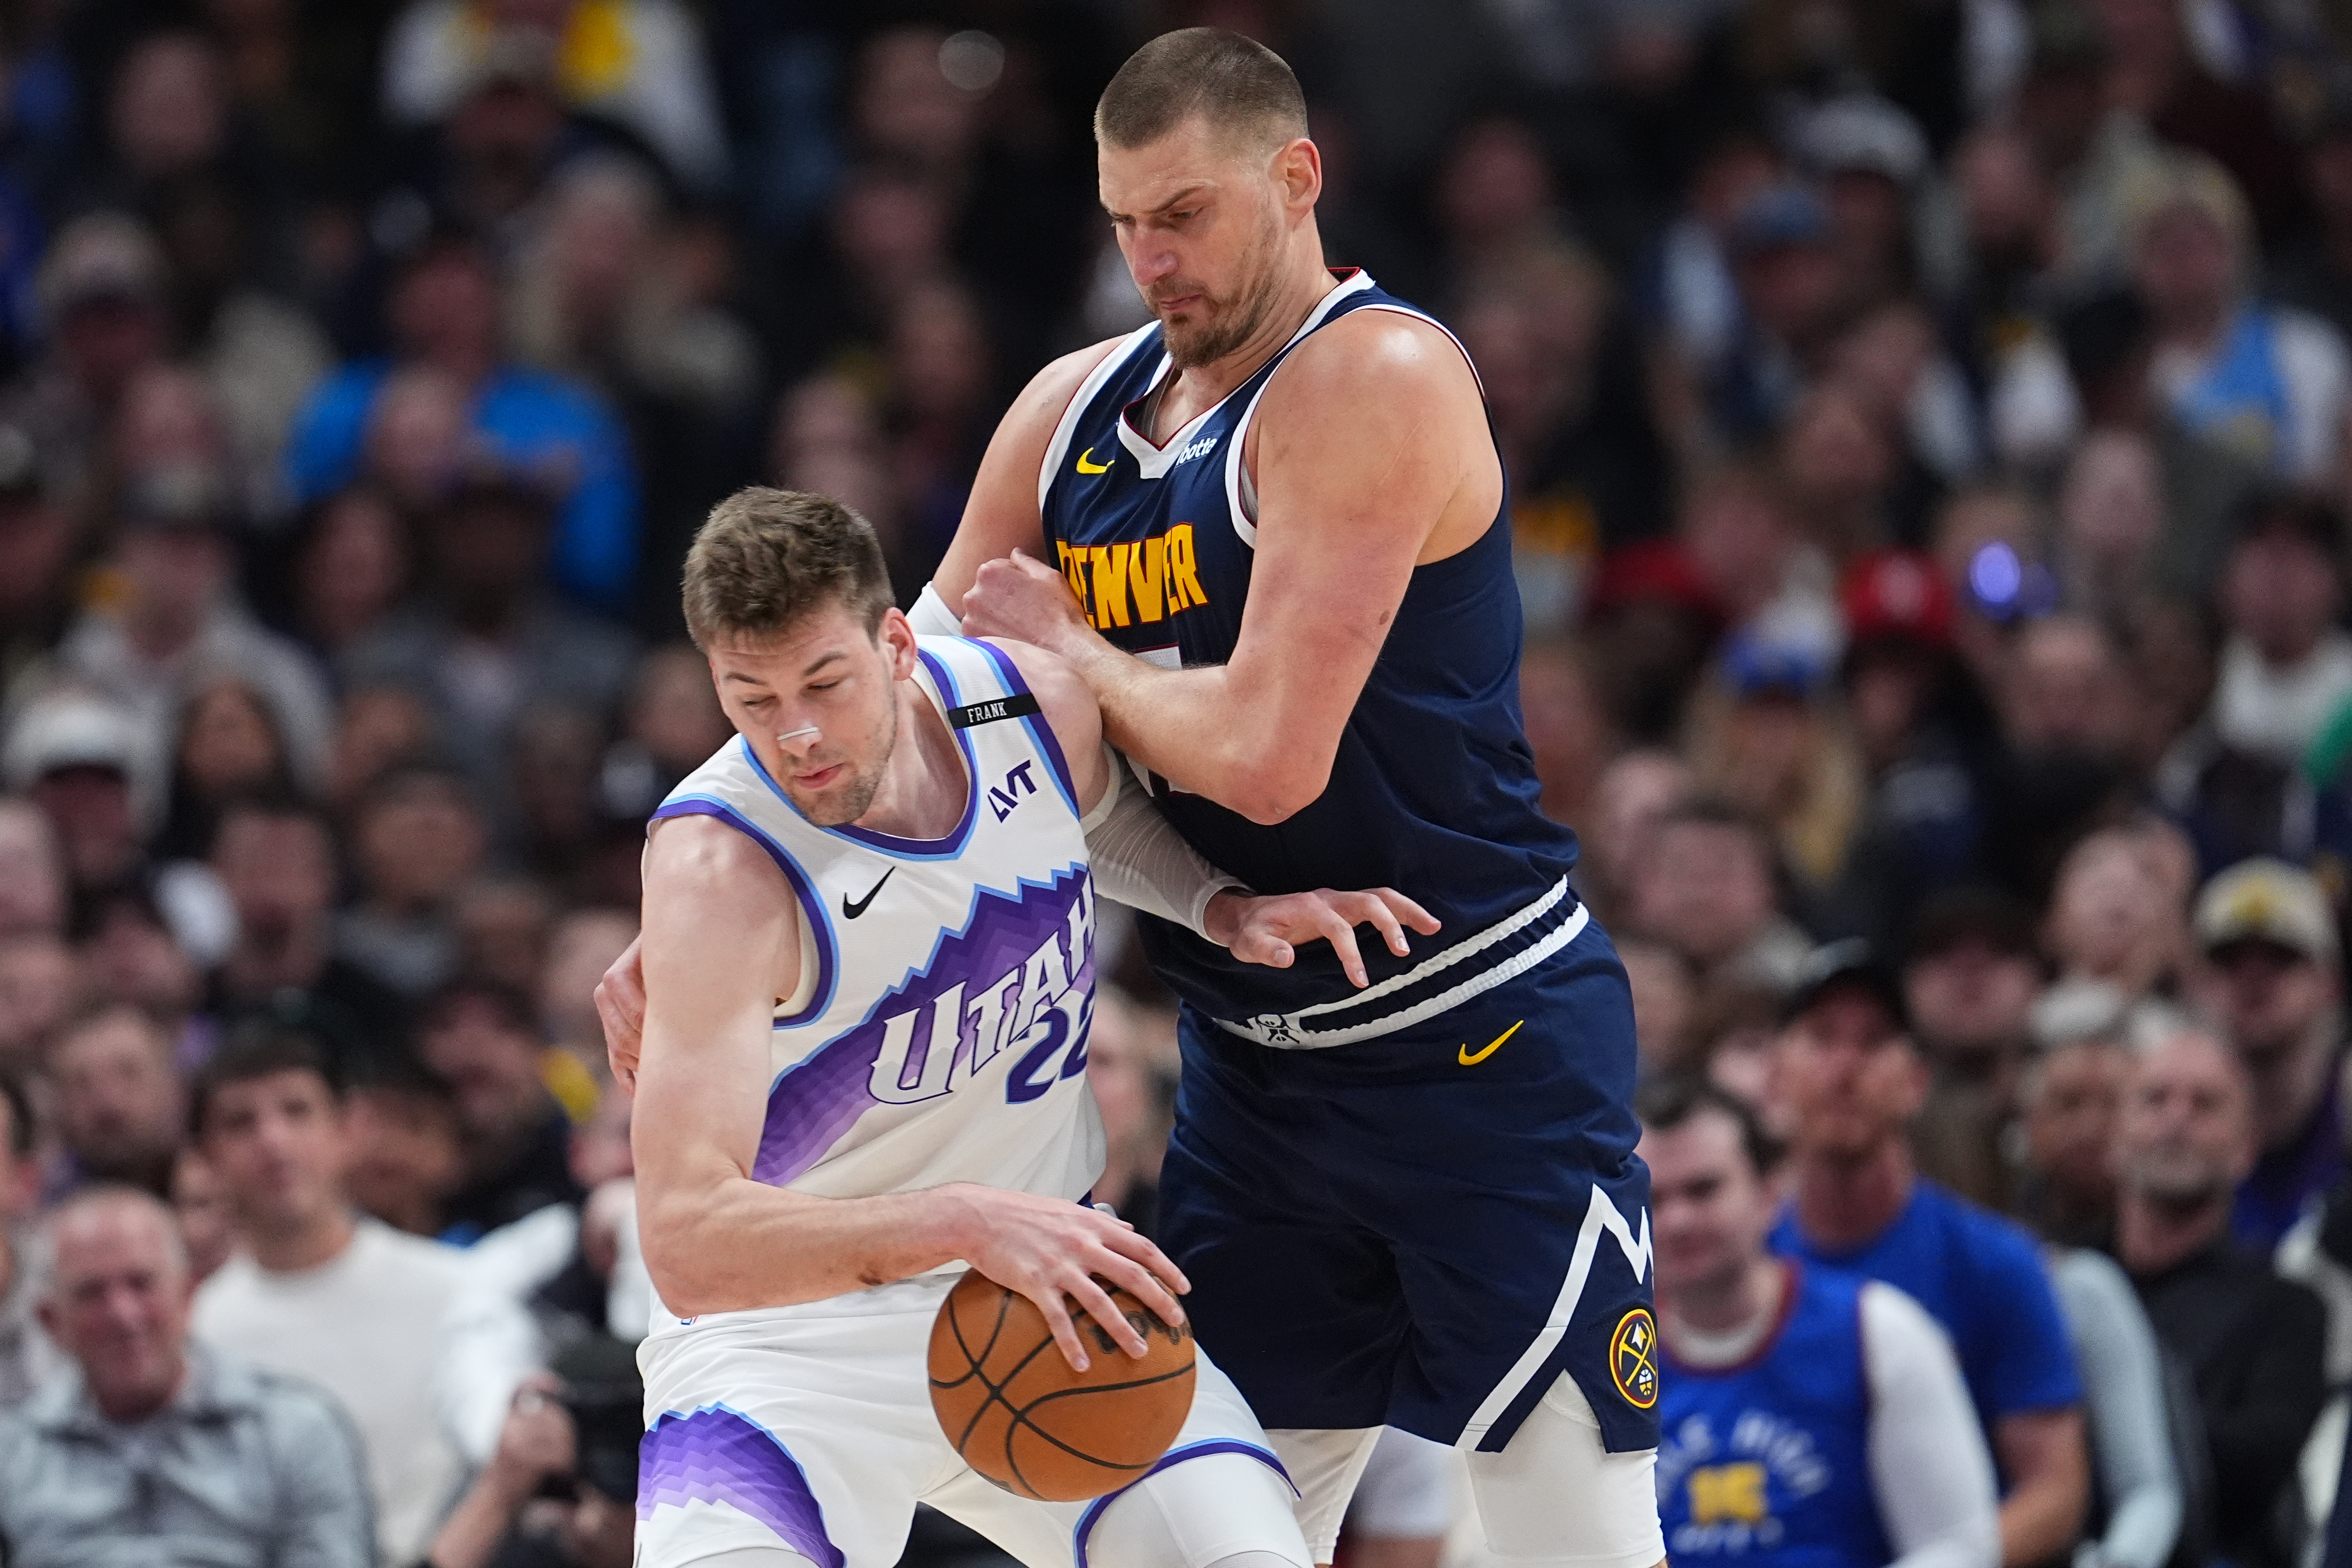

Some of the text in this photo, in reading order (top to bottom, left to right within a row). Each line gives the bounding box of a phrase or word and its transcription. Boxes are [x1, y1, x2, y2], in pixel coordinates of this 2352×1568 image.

[1056, 521, 1210, 631] DENVER
[967, 702, 1007, 723] FRANK
[866, 862, 1096, 1105] UTAH
